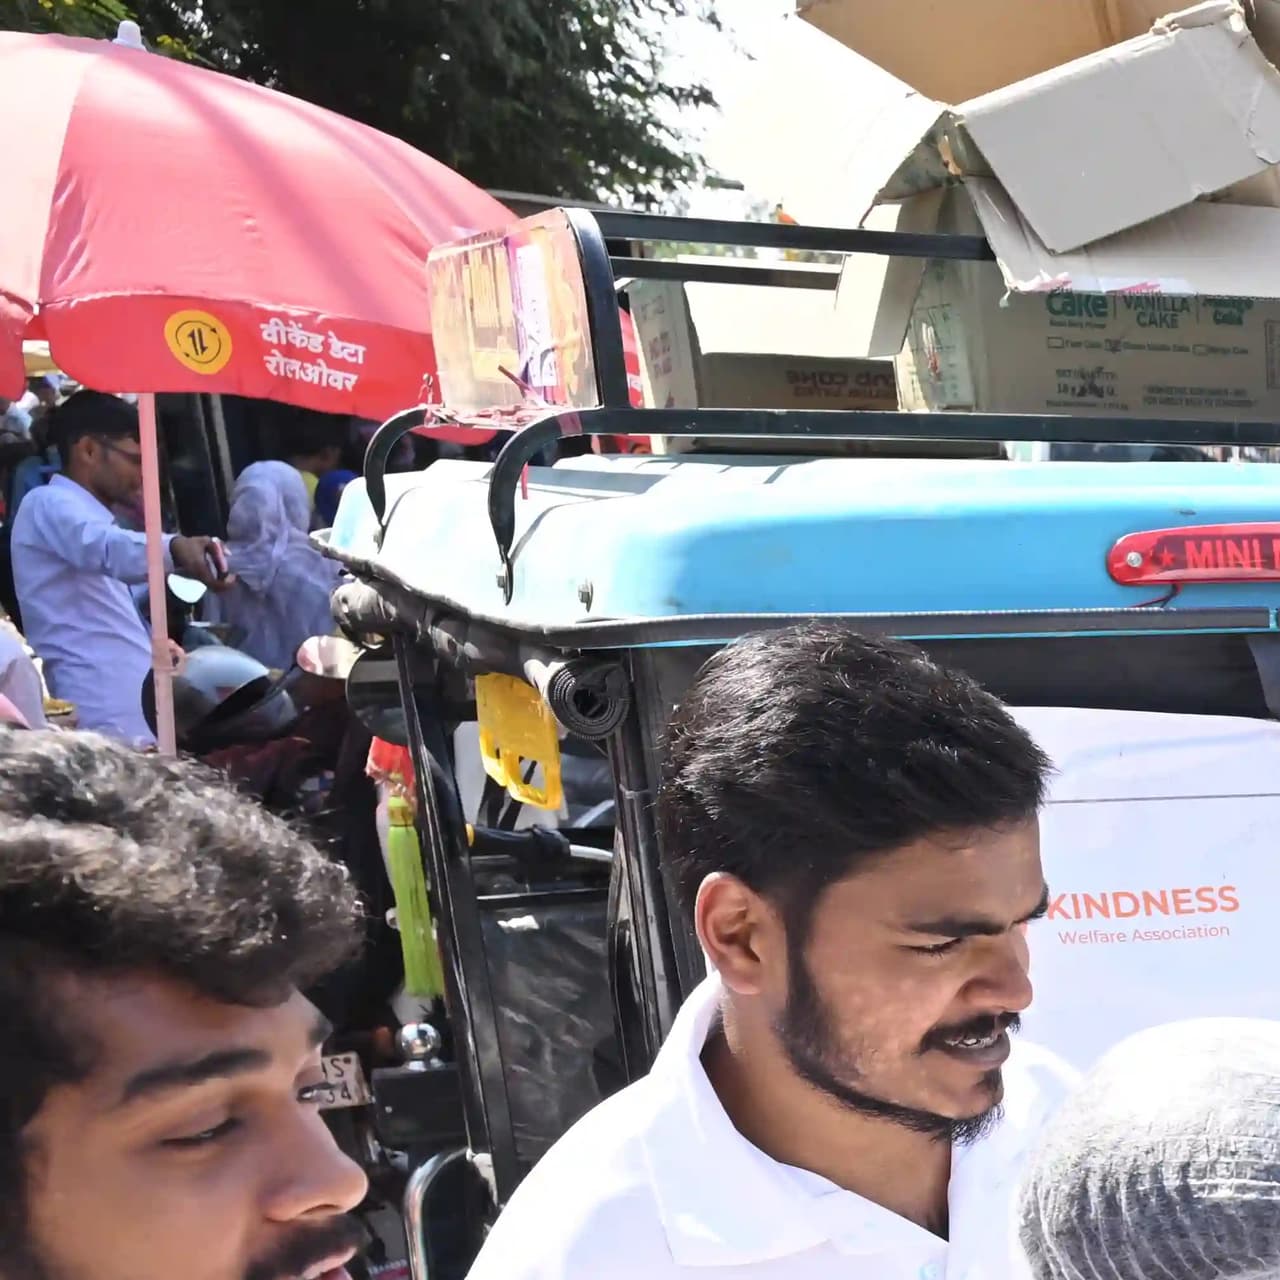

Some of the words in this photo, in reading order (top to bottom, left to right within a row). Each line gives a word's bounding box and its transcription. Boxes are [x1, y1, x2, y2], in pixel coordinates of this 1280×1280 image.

[1136, 312, 1178, 328] CAKE
[260, 317, 325, 353] वीकेंड
[328, 330, 366, 364] डेटा
[263, 349, 359, 392] रोलओवर
[1185, 538, 1261, 570] MINI
[1048, 885, 1240, 920] KINDNESS
[1058, 928, 1127, 945] Welfare
[1132, 924, 1231, 942] Association
